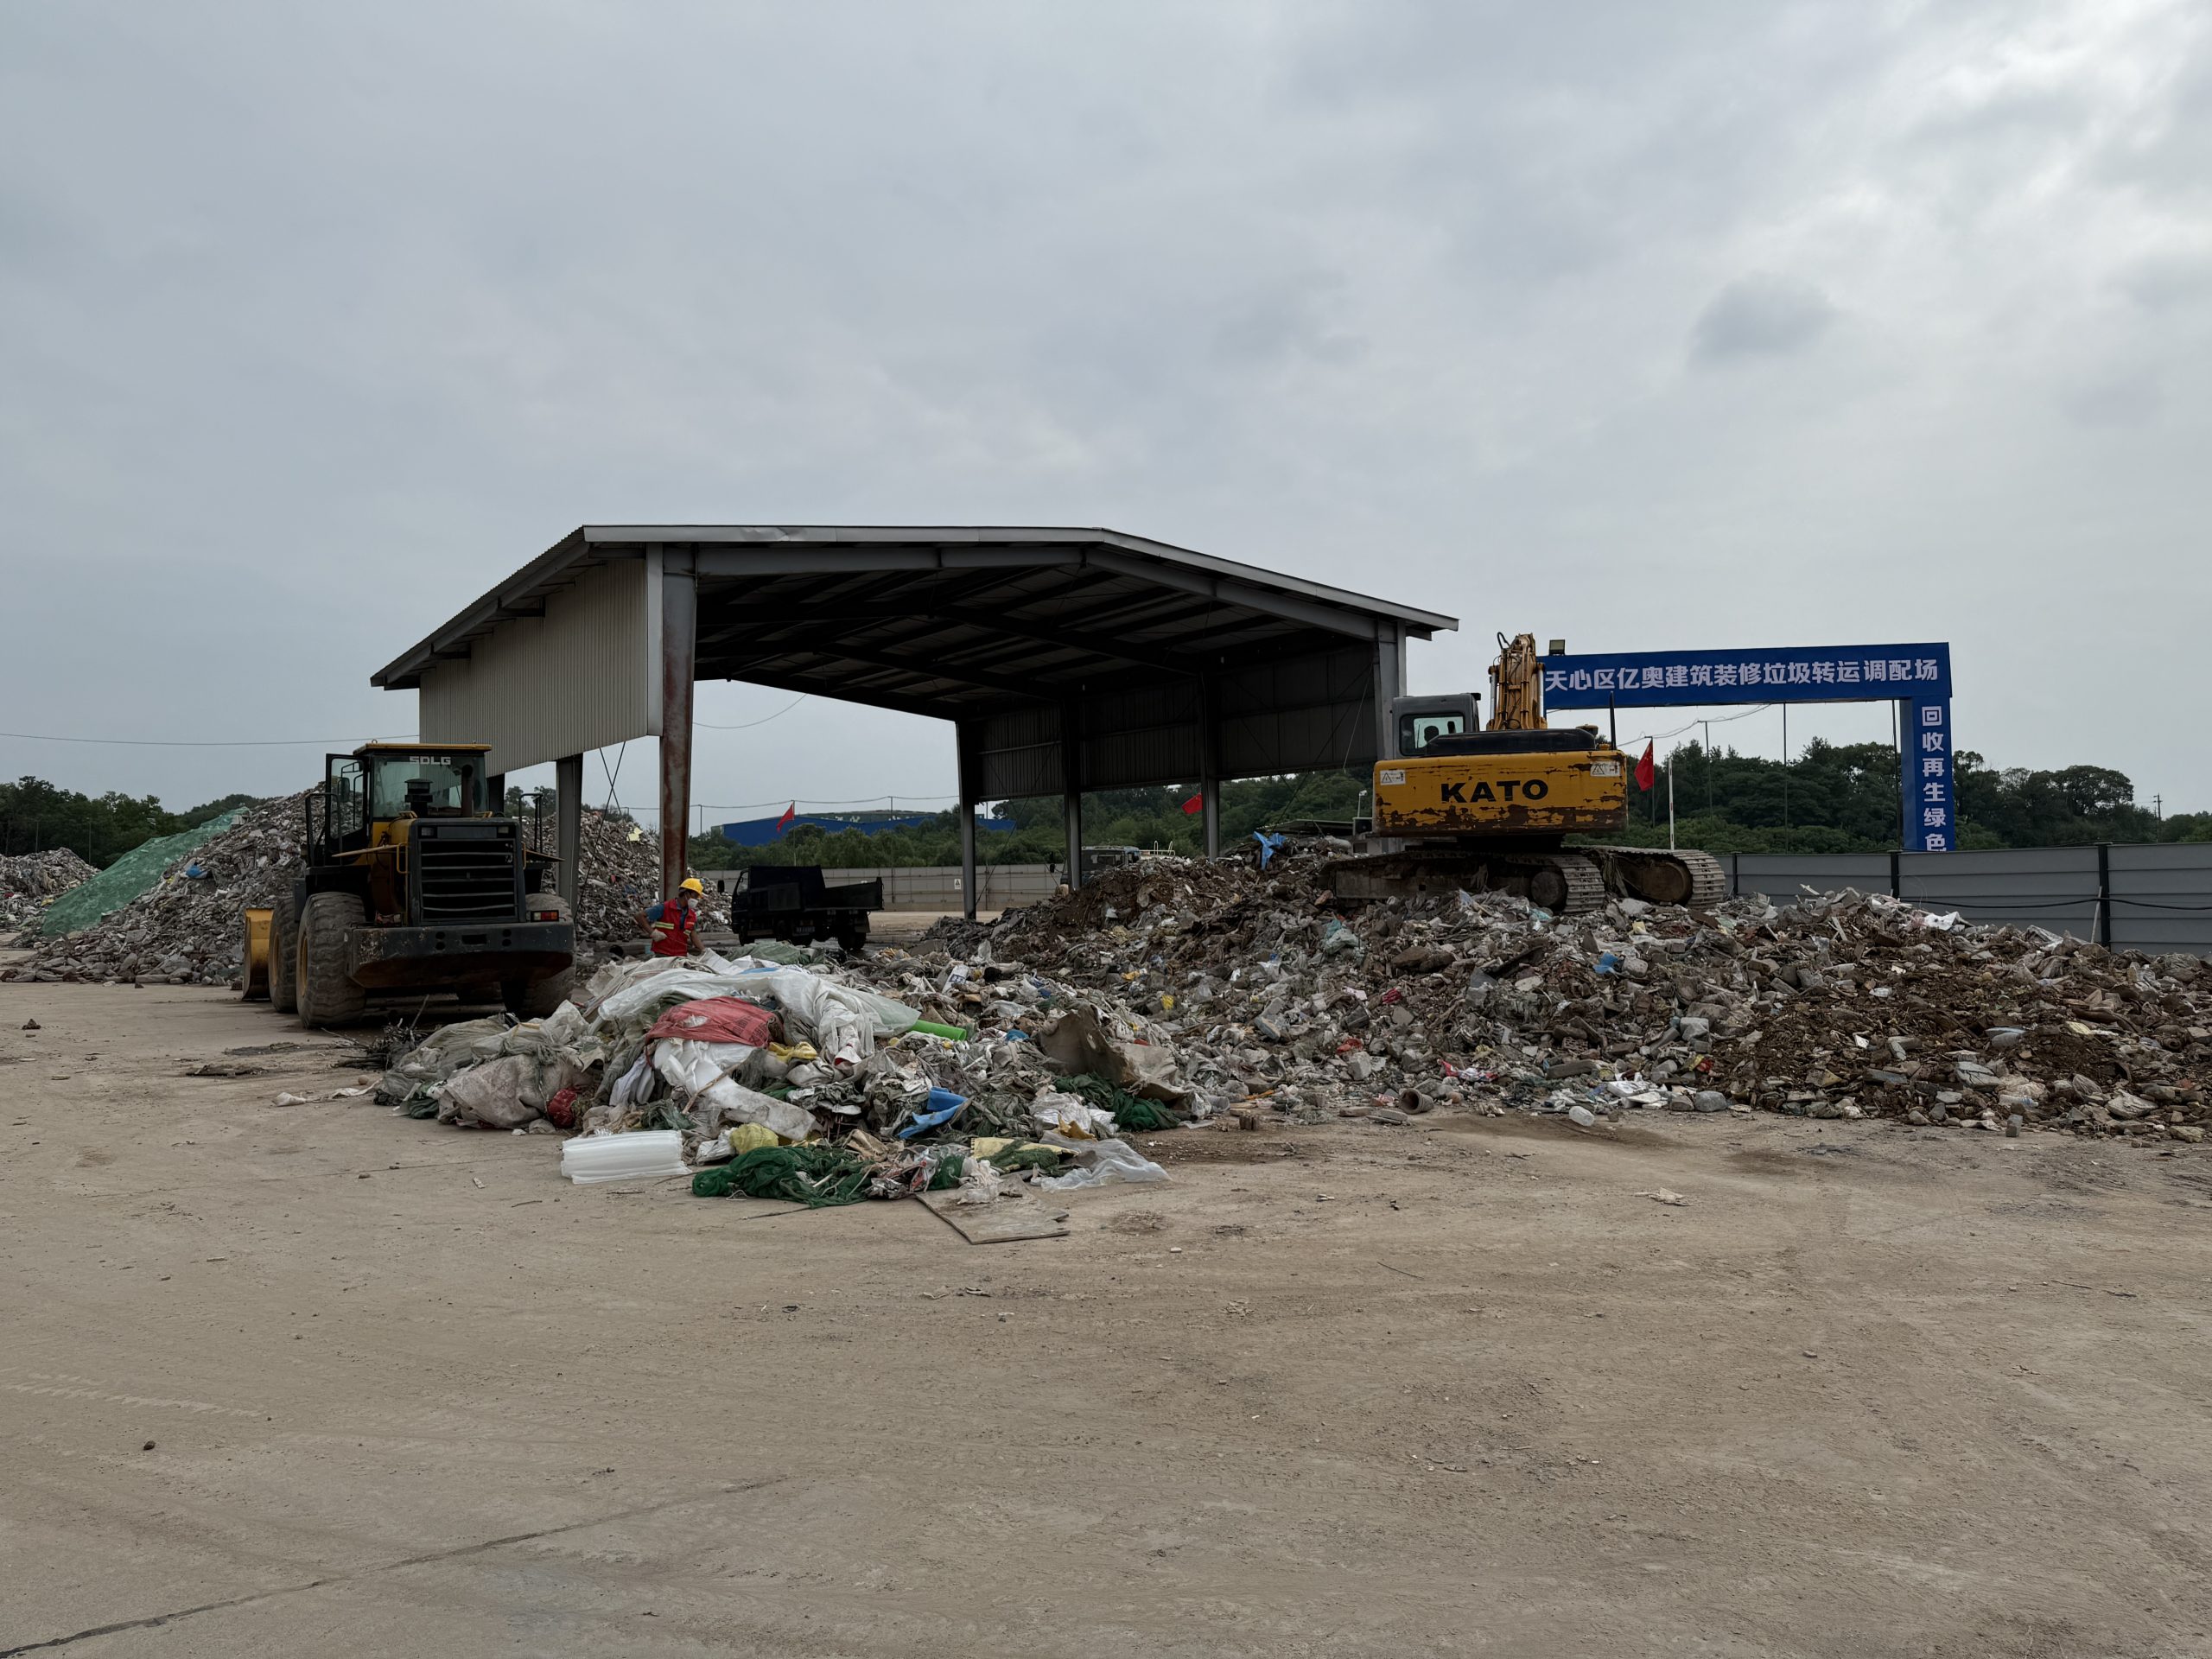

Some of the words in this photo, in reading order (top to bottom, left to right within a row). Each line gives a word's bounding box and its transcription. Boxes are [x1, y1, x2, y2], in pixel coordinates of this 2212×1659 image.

[1545, 658, 1938, 692] 天心区亿奥建筑装修垃圾转运调配场
[409, 755, 452, 766] SDLG
[1440, 779, 1549, 804] KATO
[1921, 705, 1947, 852] 回收再生绿色
